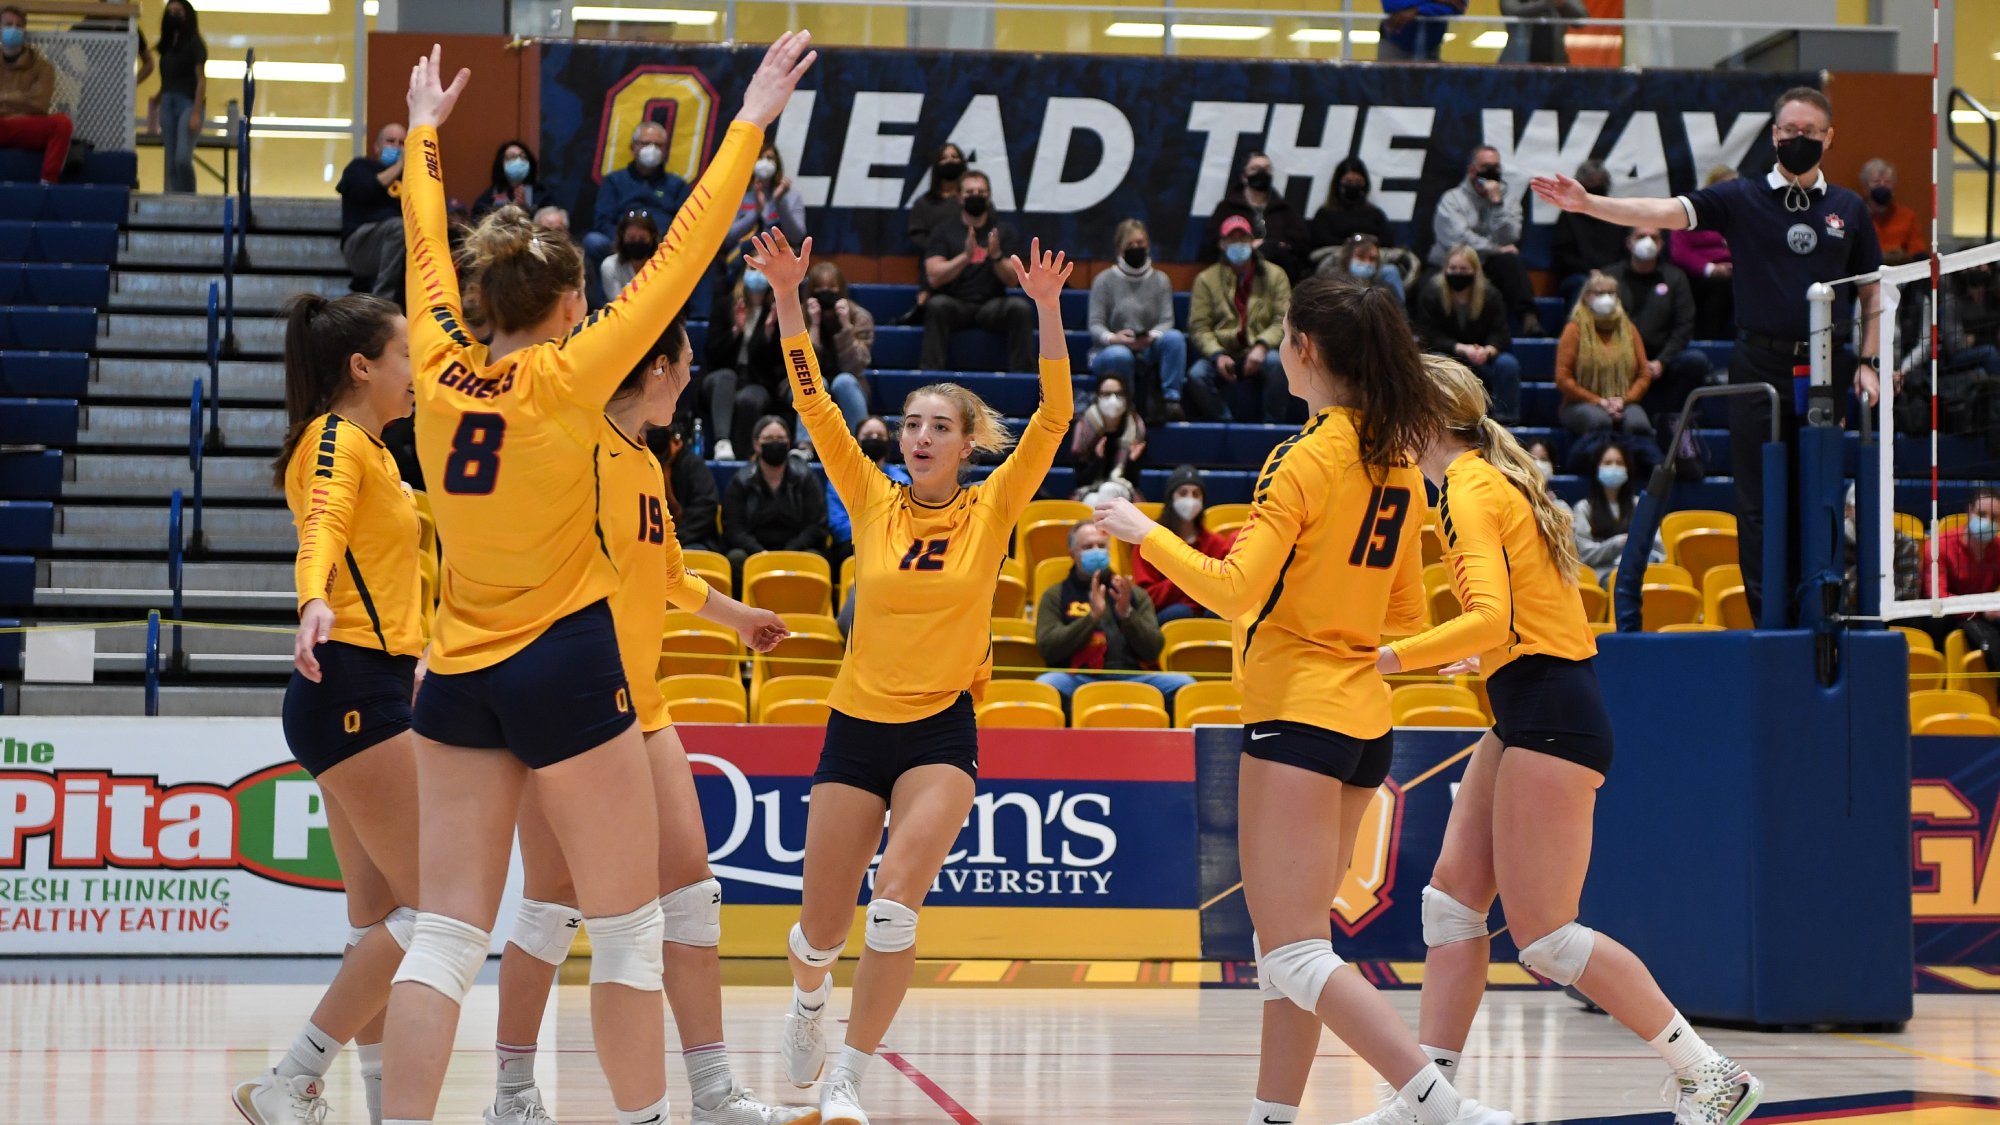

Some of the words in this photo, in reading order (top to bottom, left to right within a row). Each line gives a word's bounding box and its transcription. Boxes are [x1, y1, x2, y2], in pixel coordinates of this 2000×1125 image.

[774, 90, 1134, 213] LEAD
[1187, 101, 1436, 221] THE
[1482, 108, 1772, 224] WAY
[443, 411, 507, 496] 8
[638, 492, 664, 545] 19
[1348, 485, 1411, 570] 13
[898, 536, 951, 571] 12
[0, 737, 55, 763] he
[0, 778, 233, 861] Pita
[687, 753, 1117, 891] Qun's
[81, 877, 230, 902] THINKING
[867, 868, 1113, 894] IVERSITY
[120, 906, 230, 933] EATING
